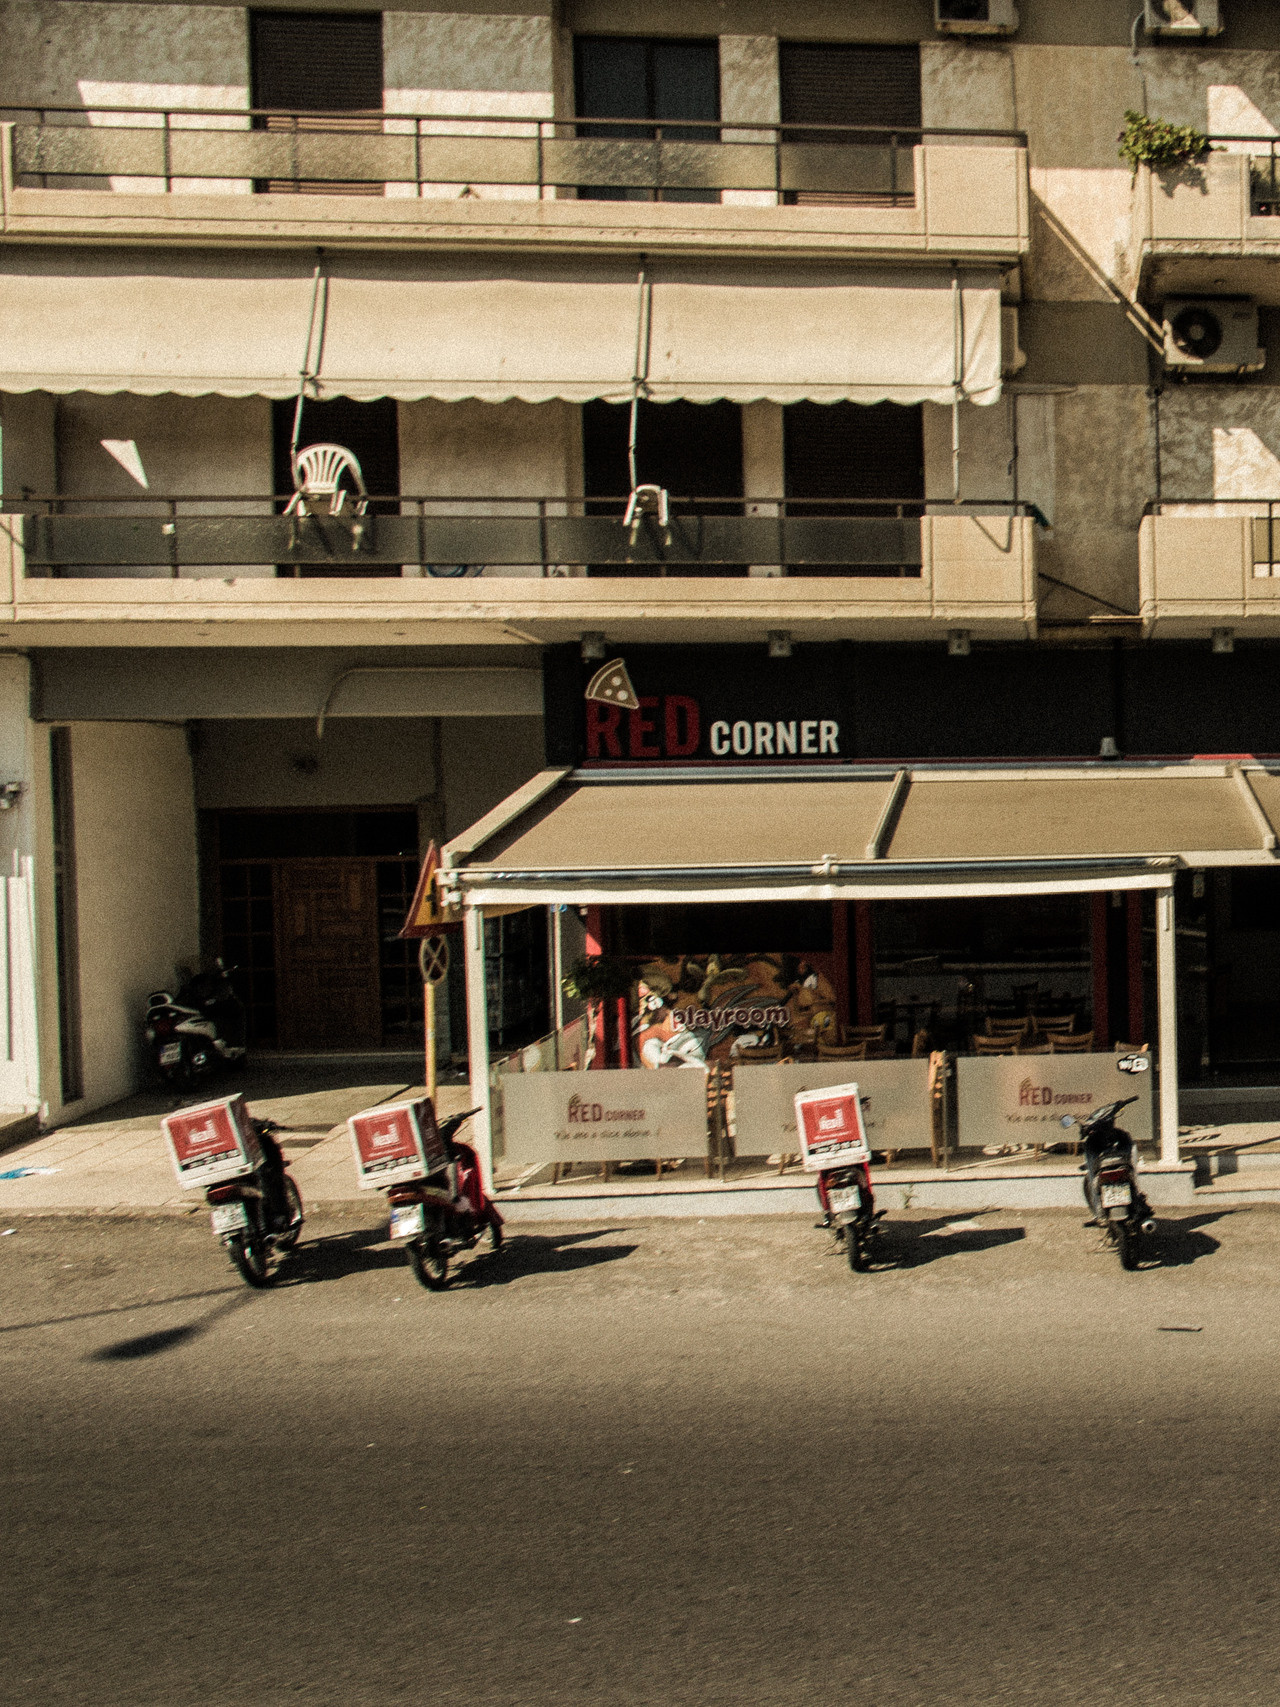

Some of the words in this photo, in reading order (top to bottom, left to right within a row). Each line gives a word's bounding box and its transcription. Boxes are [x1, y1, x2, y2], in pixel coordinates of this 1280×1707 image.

[586, 695, 699, 757] RED
[710, 720, 840, 755] CORNER
[670, 1005, 789, 1032] playroom
[1020, 1086, 1052, 1106] RED
[568, 1103, 602, 1122] RED
[605, 1109, 645, 1121] CORNER
